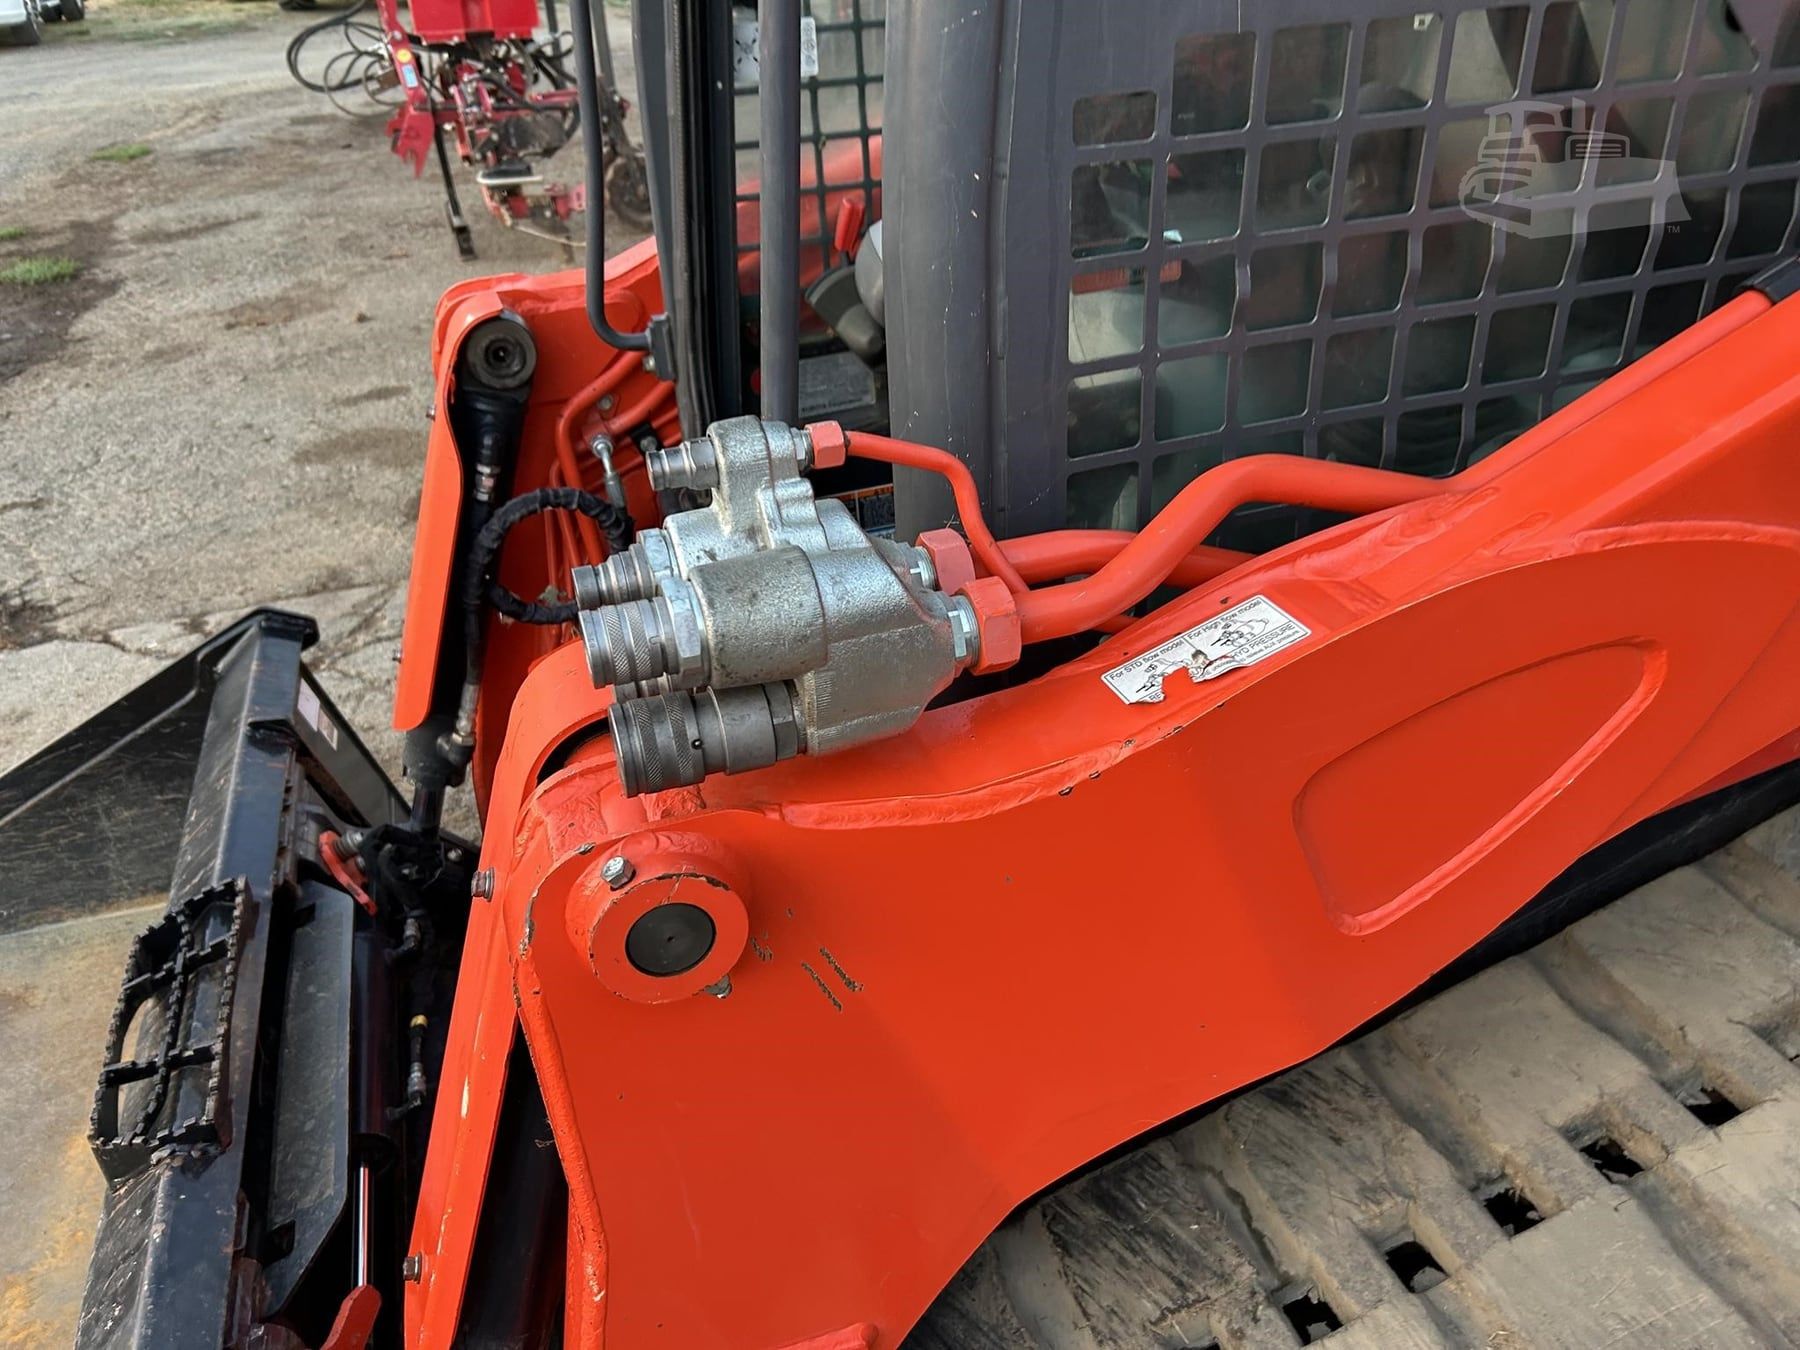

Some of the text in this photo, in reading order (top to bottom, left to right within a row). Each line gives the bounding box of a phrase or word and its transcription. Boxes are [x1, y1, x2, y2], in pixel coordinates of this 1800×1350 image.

[1187, 600, 1261, 640] For High flow model
[1109, 640, 1184, 681] For STD flow model
[1232, 648, 1250, 659] HYD
[1249, 623, 1295, 650] PRESSURE
